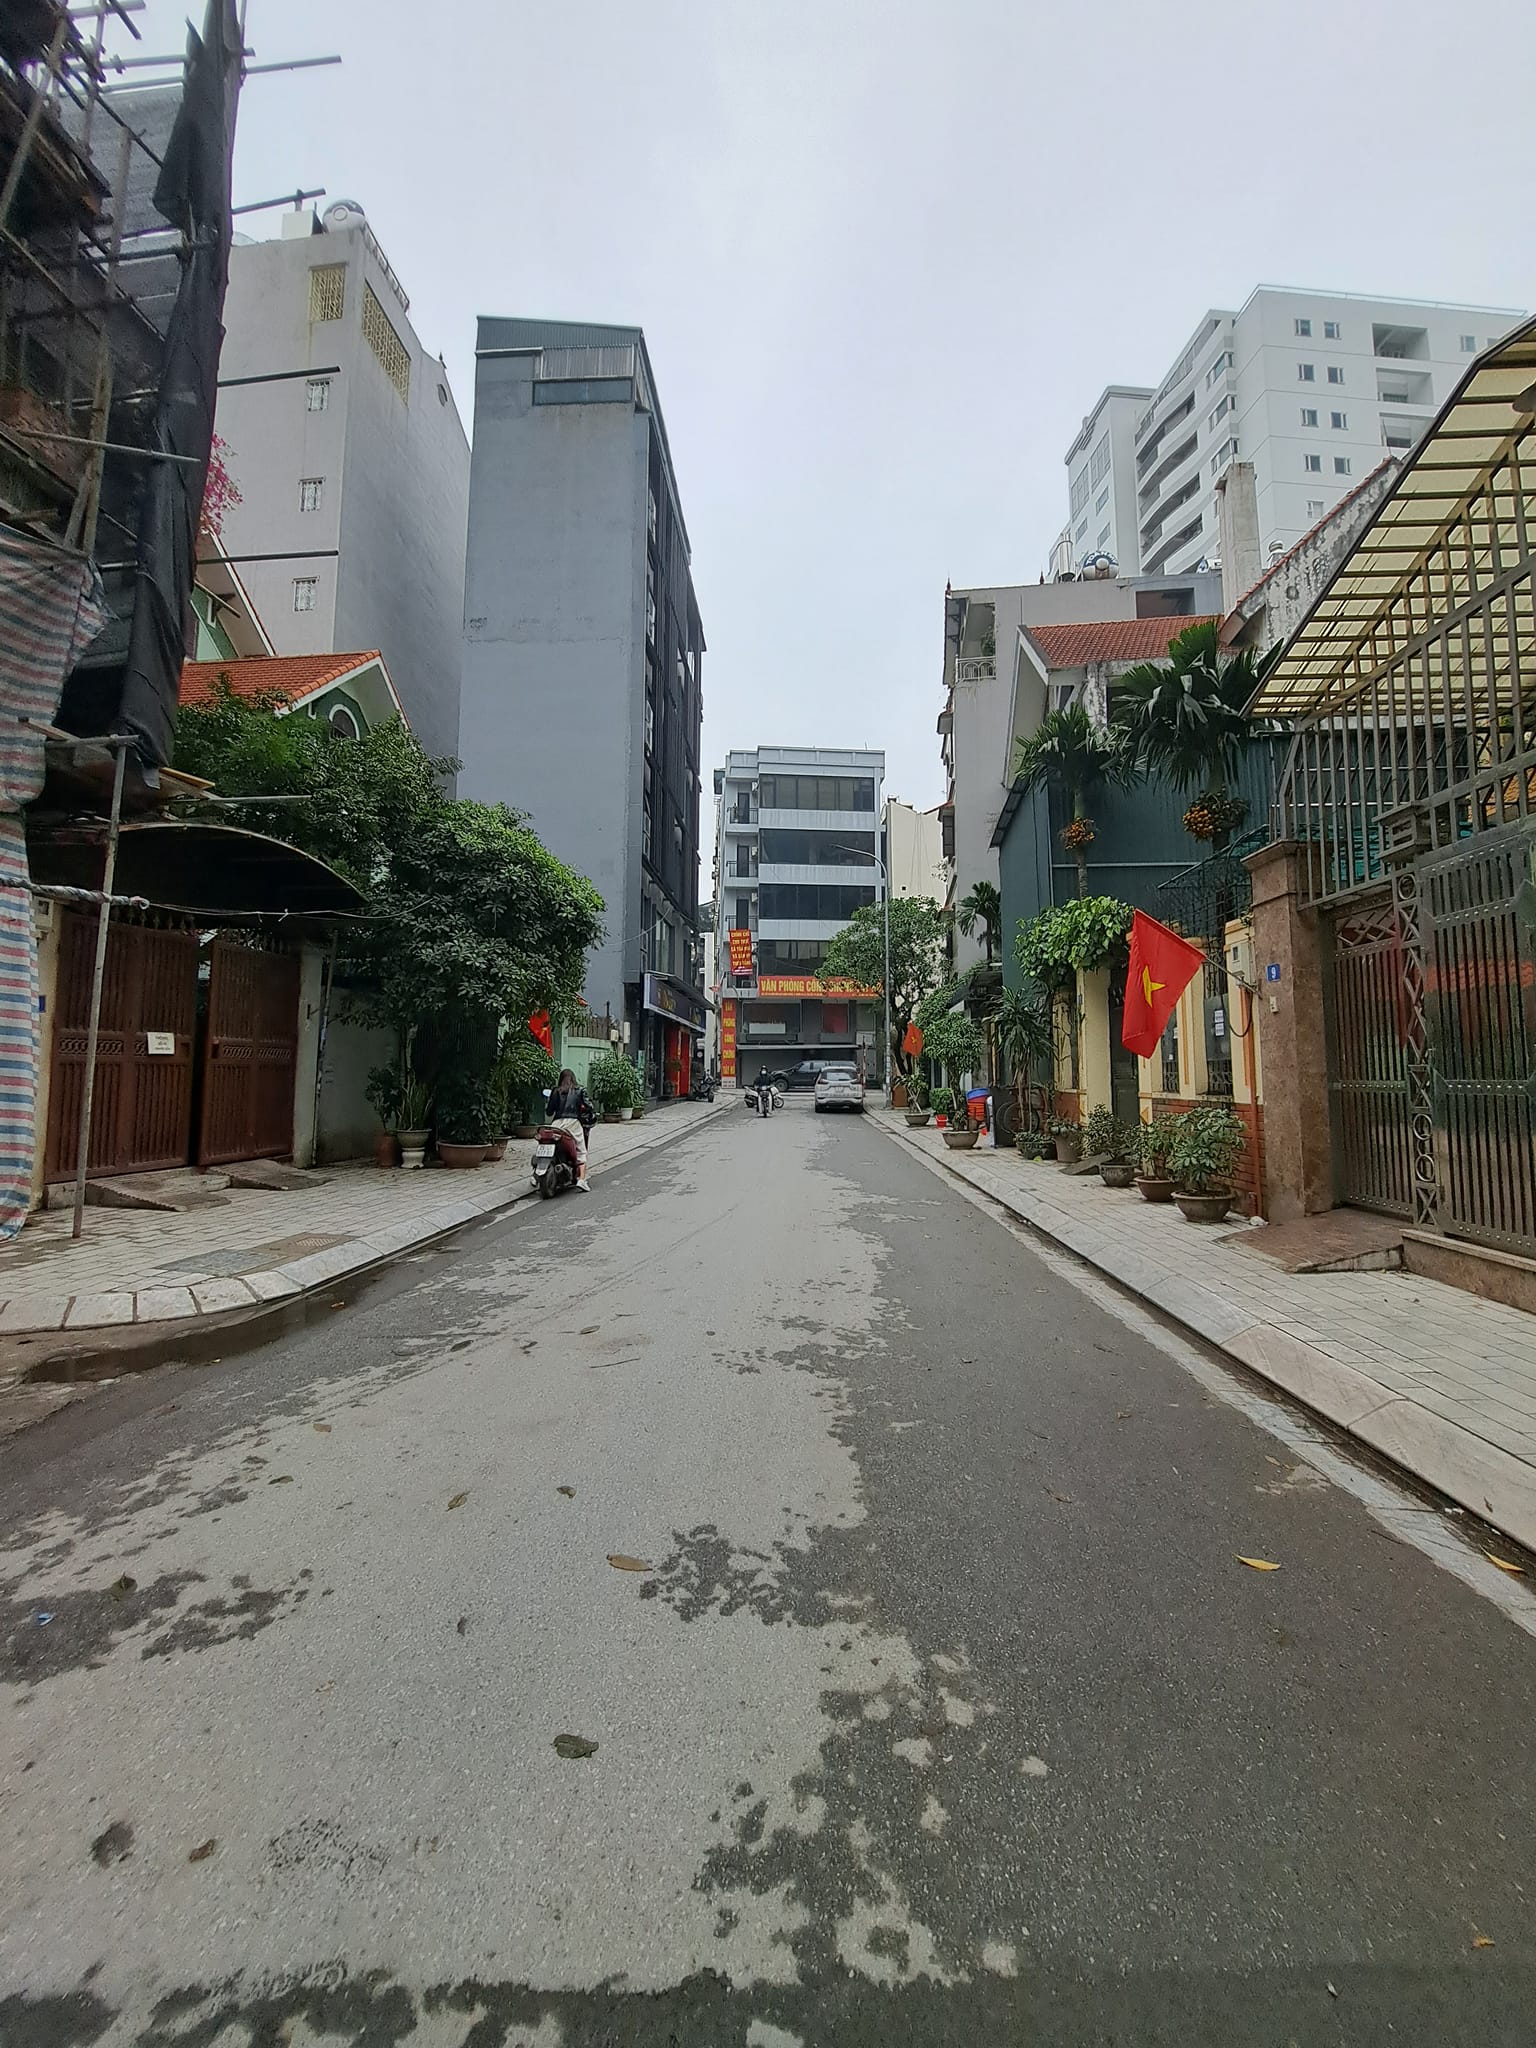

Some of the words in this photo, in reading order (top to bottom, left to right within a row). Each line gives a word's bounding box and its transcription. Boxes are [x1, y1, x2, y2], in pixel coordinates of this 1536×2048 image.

[1271, 966, 1276, 979] 9
[761, 979, 777, 992] VĂN
[778, 978, 805, 992] PHÒNG
